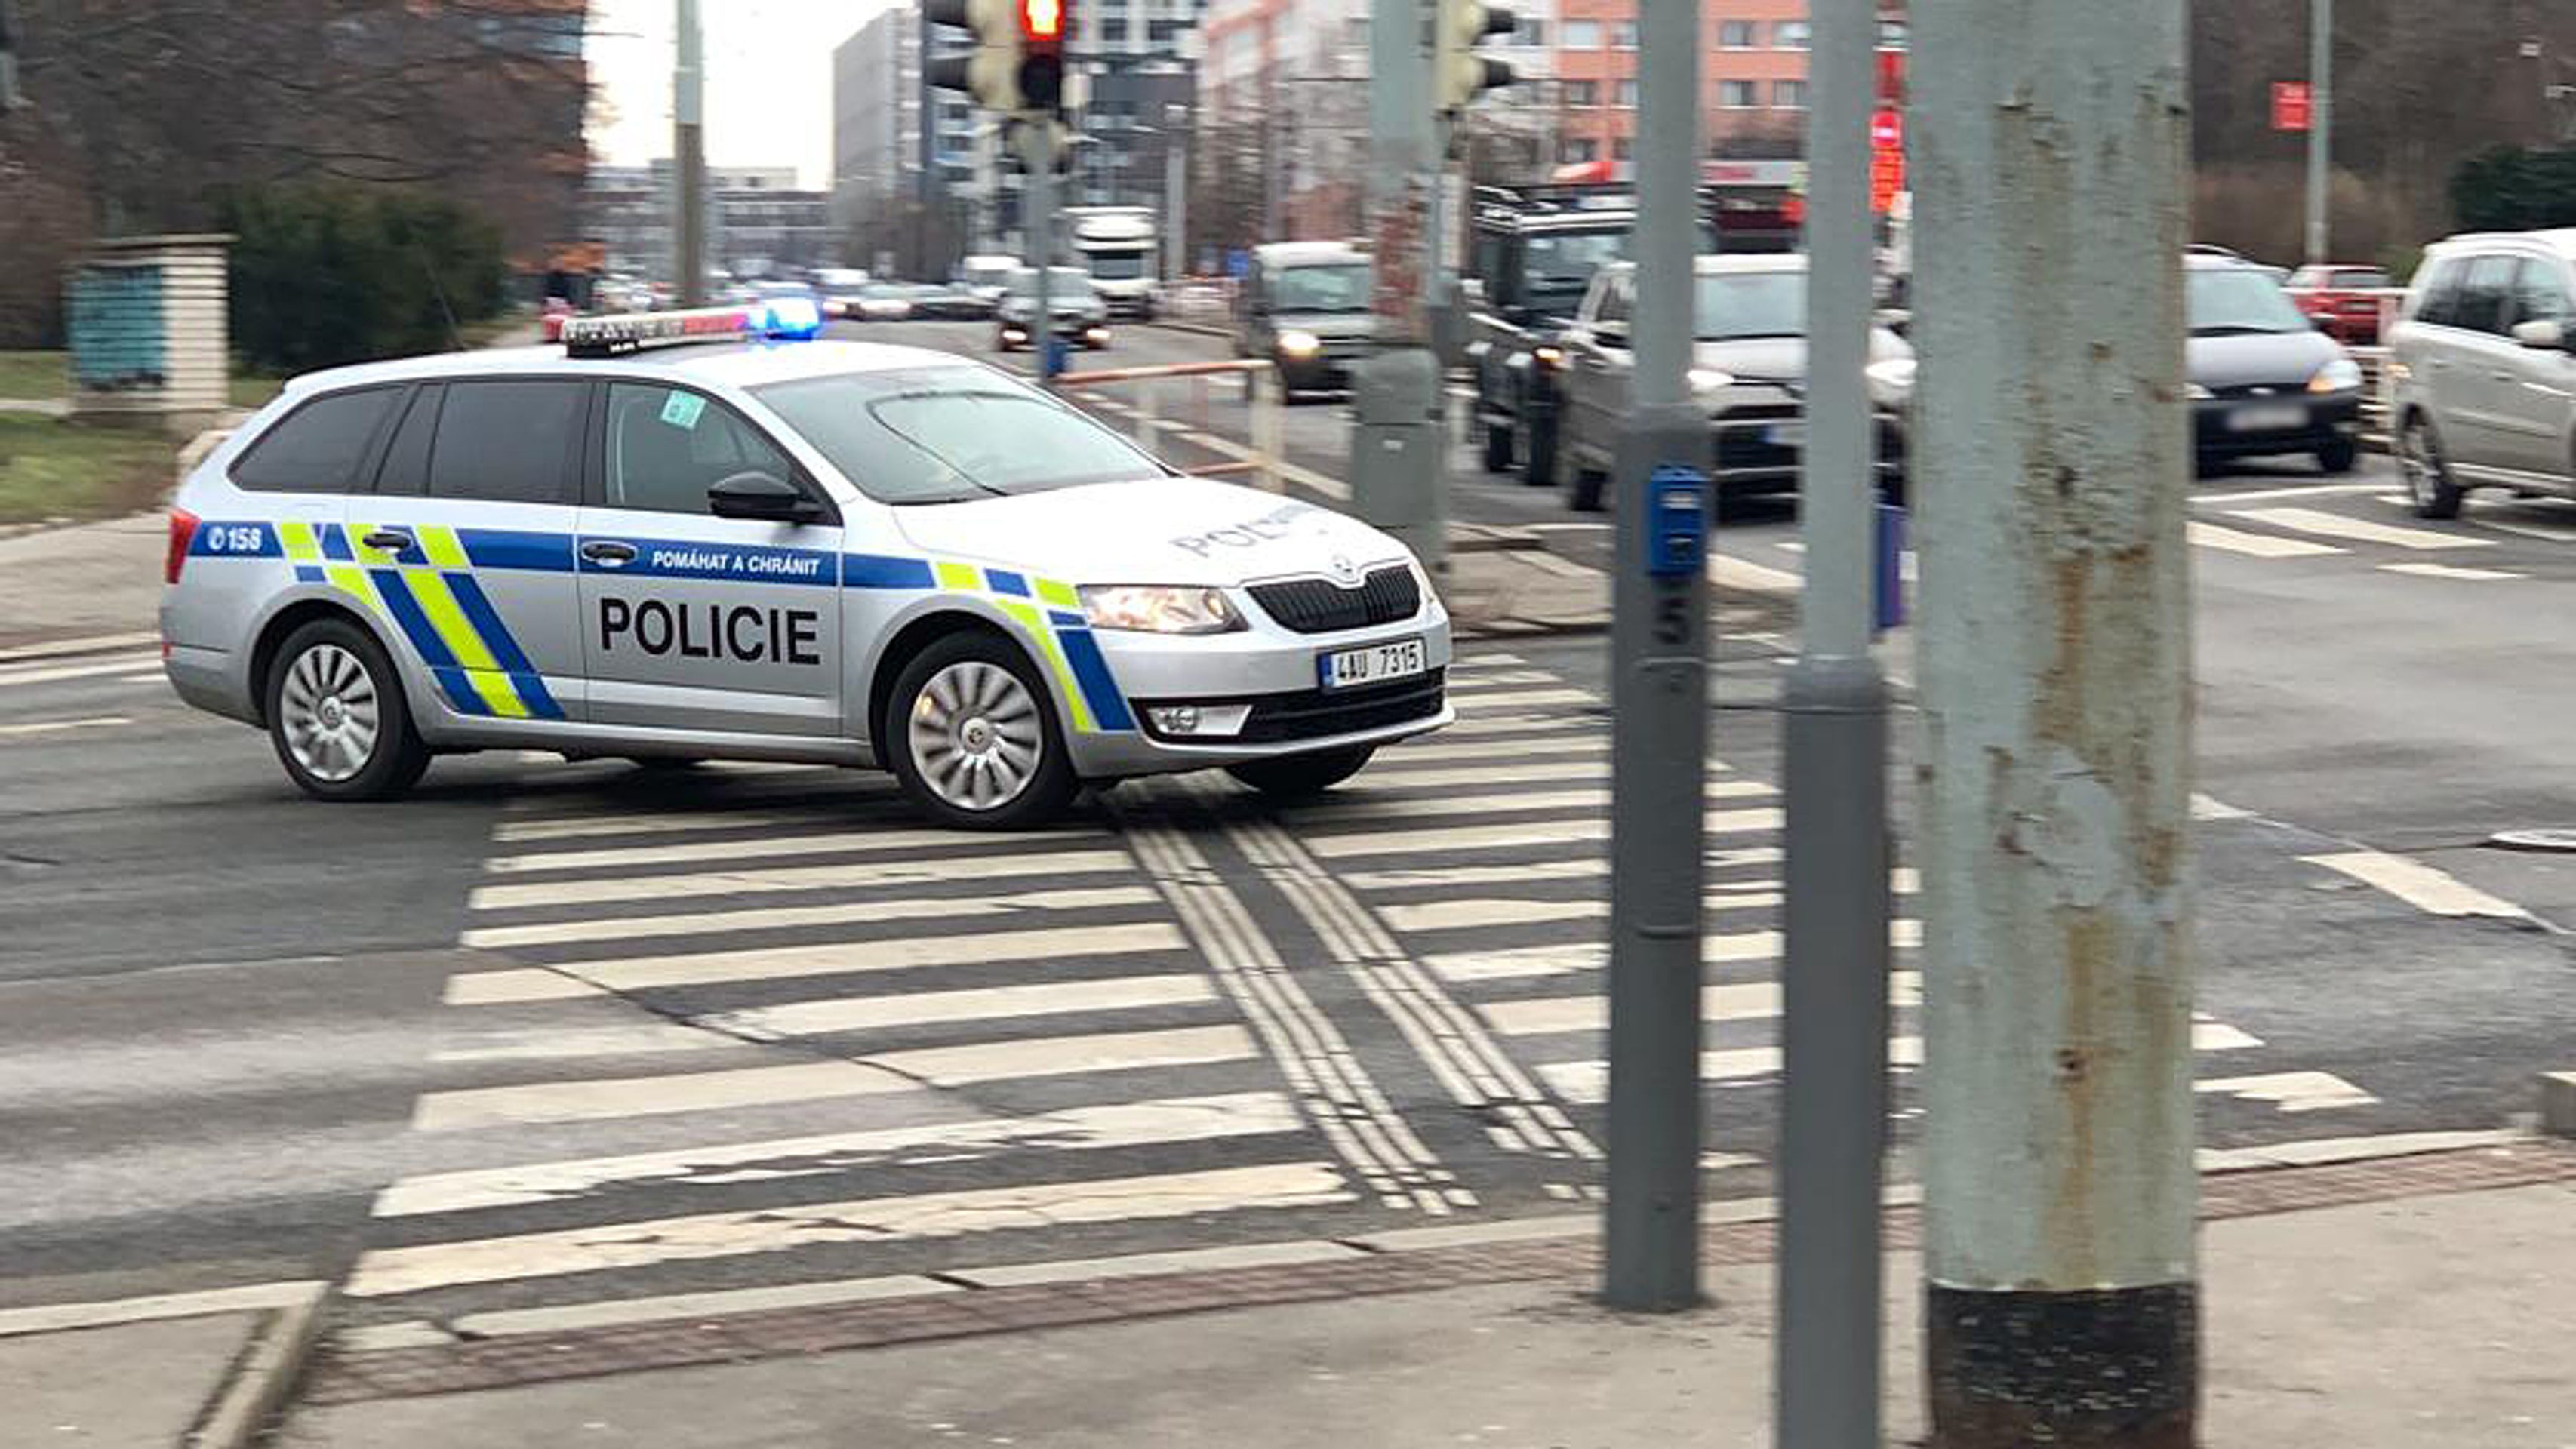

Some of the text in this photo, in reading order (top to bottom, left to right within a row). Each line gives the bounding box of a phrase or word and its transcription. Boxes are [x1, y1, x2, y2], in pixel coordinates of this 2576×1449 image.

[228, 526, 263, 551] 158
[652, 548, 821, 576] POMÁHAT A CHRÁNIT
[600, 598, 820, 665] POLICIE
[1379, 642, 1417, 675] 7315
